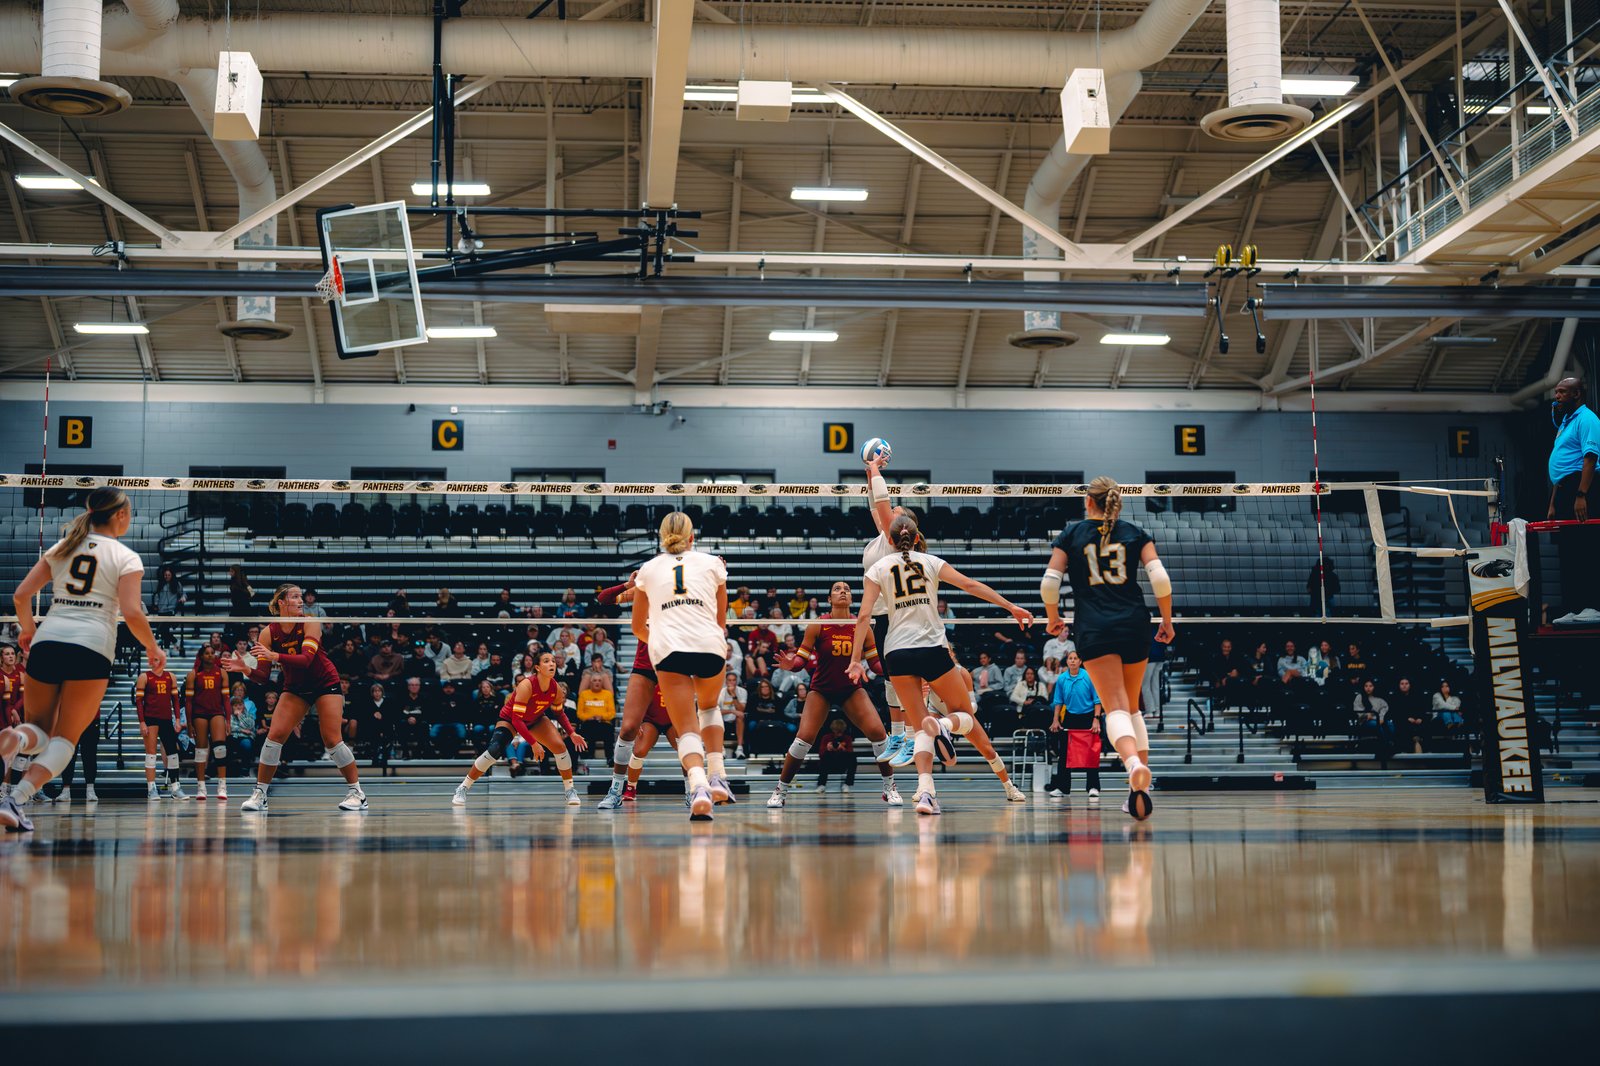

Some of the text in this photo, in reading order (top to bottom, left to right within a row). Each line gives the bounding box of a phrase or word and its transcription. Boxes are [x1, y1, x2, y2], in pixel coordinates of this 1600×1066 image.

[66, 419, 84, 445] B
[437, 421, 458, 448] C
[828, 425, 848, 451] D
[1182, 427, 1197, 453] E
[1457, 430, 1470, 454] F
[20, 477, 64, 486] PANTHERS
[107, 478, 150, 488] PANTHERS
[192, 480, 235, 488] PANTHERS
[278, 482, 320, 490] PANTHERS
[362, 482, 404, 491] PANTHERS
[446, 484, 488, 492] PANTHERS
[530, 484, 572, 493] PANTHERS
[614, 485, 655, 494] PANTHERS
[696, 486, 737, 494] PANTHERS
[778, 486, 820, 494] PANTHERS
[942, 486, 982, 494] PANTHERS
[1022, 486, 1063, 494] PANTHERS
[1118, 486, 1143, 494] THERS
[1182, 486, 1222, 494] PANTHERS
[1261, 485, 1300, 494] PANTHERS
[66, 554, 98, 596] 9
[1083, 543, 1128, 586] 13
[672, 564, 688, 595] 1
[890, 562, 927, 599] 12
[894, 598, 930, 610] MILWAUKEE
[831, 640, 852, 657] 30
[156, 684, 166, 694] 12
[204, 679, 214, 690] 18
[533, 705, 545, 714] 7
[1486, 617, 1533, 793] MILWAUKEE
